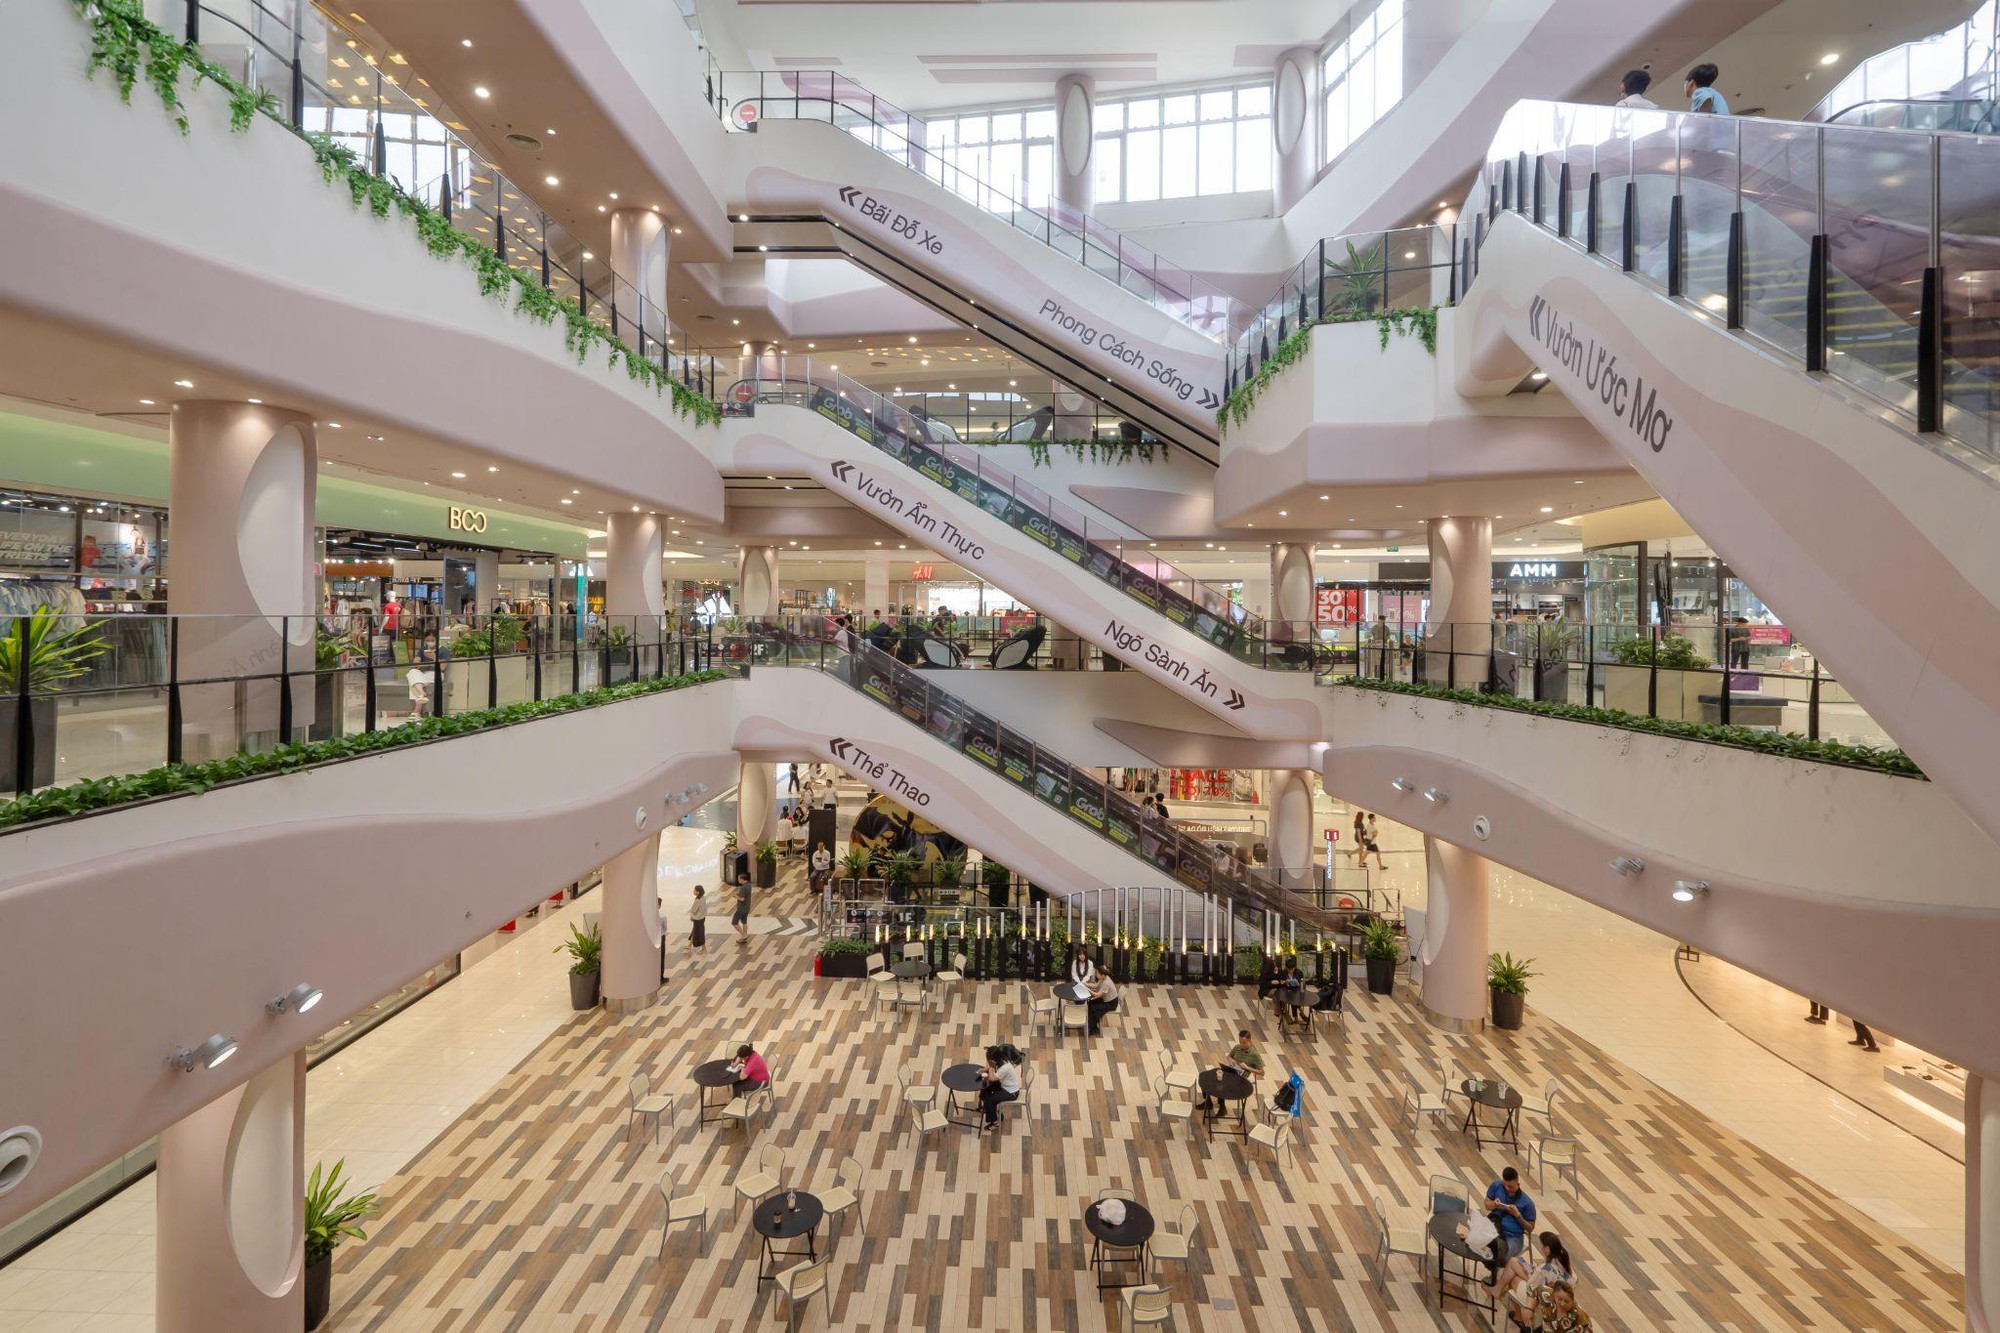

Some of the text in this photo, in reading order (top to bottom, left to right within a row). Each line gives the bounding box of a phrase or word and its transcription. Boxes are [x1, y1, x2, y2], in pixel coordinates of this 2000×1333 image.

[859, 196, 943, 254] Bãi Đỗ Xe
[1039, 299, 1194, 400] Phong Cách Sống
[1546, 305, 1673, 453] Vườn Ước Mơ
[856, 472, 904, 513] Vườn
[939, 521, 985, 560] Thực
[1028, 517, 1059, 539] Grab
[1509, 563, 1557, 577] AMM
[1104, 620, 1218, 697] Ngõ Sành Ăn
[852, 747, 930, 806] Thể Thao
[1075, 797, 1105, 820] Grab
[1180, 859, 1210, 882] Grab
